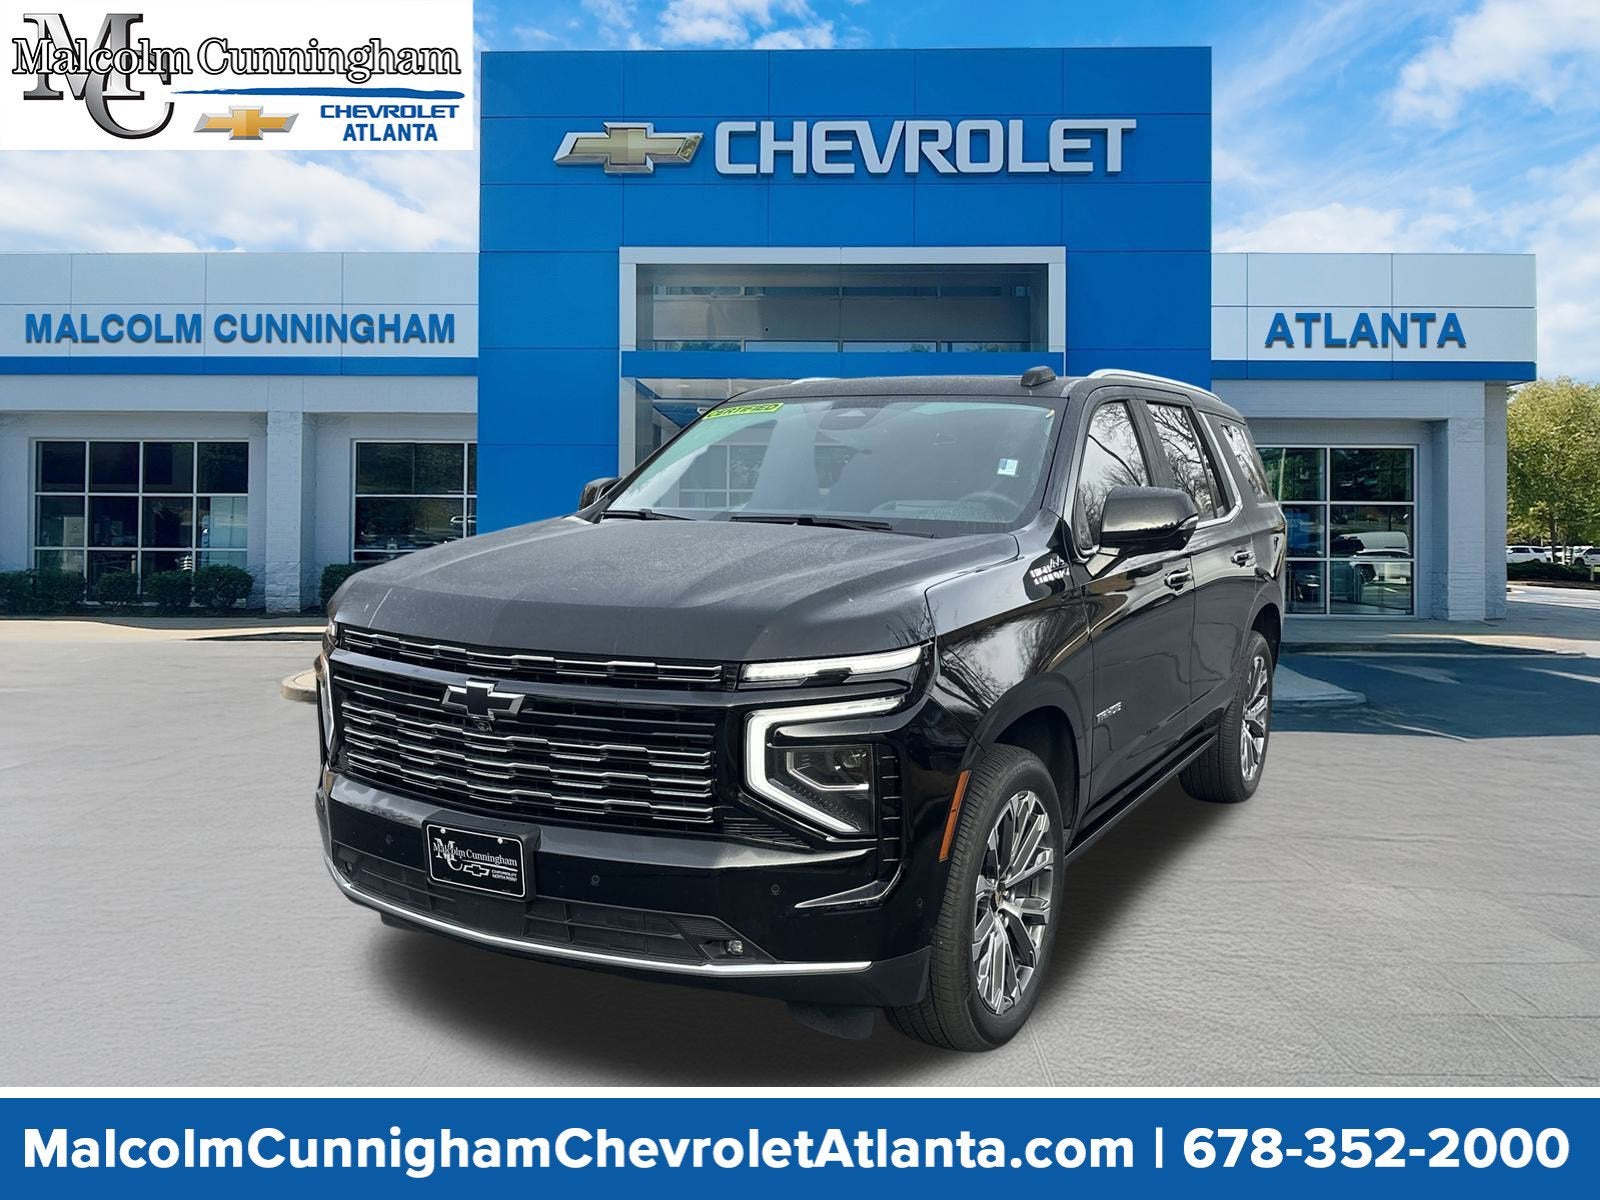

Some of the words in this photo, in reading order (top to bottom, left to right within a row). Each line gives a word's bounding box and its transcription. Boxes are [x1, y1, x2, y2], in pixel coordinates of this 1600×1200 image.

[715, 118, 1137, 175] CHEVROLET
[25, 313, 202, 343] MALCOLM
[213, 313, 455, 343] CUNNINGHAM
[1264, 312, 1467, 348] ATLANTA
[466, 848, 518, 867] Cunningham
